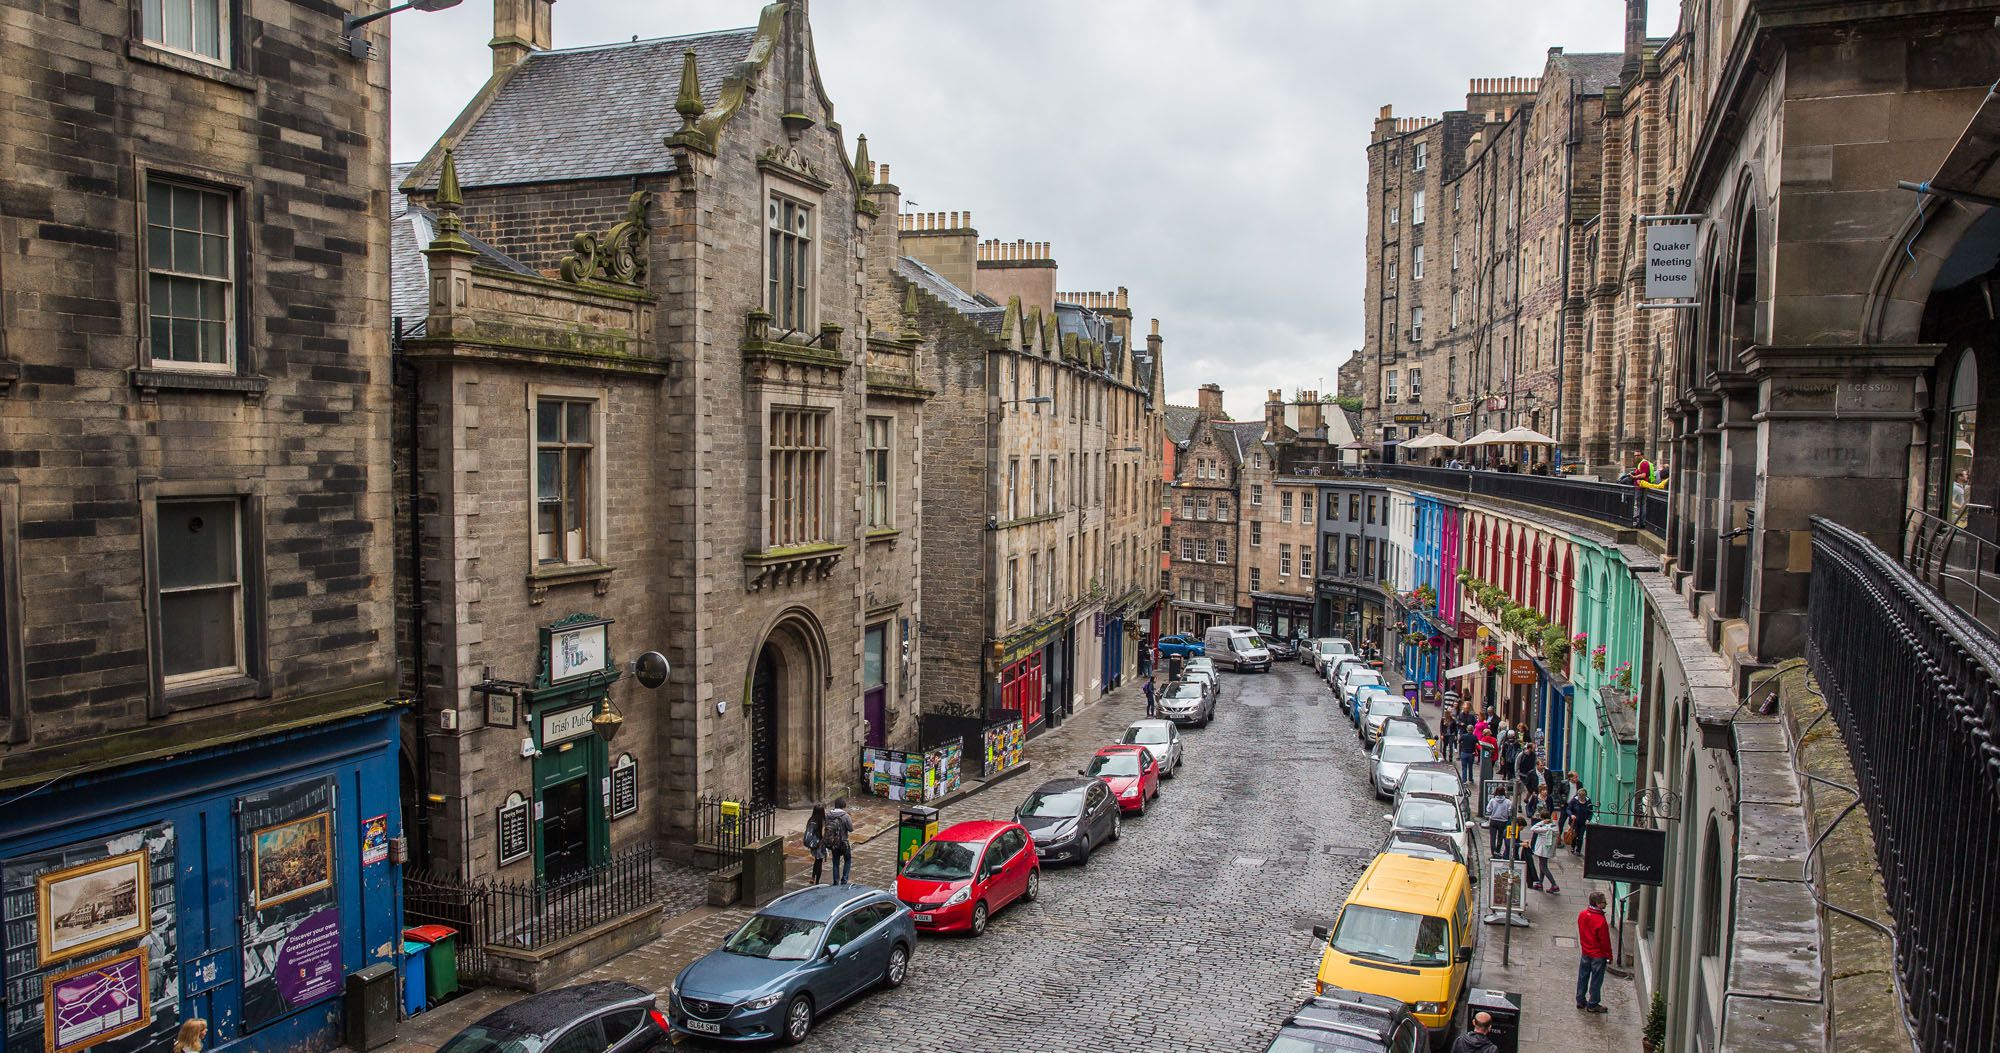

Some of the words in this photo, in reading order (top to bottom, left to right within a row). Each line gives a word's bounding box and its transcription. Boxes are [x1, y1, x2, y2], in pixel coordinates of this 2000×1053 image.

[1653, 242, 1691, 252] Quaker
[1651, 257, 1692, 268] Meeting
[1654, 273, 1688, 282] House
[1846, 383, 1900, 392] ECESSION
[552, 717, 569, 734] Irish
[572, 715, 585, 728] Pub
[1596, 860, 1625, 868] Walker
[1626, 862, 1651, 871] Slater
[290, 931, 312, 943] Discover
[312, 926, 324, 936] your
[325, 923, 336, 931] own
[286, 941, 306, 952] Greater
[690, 1021, 705, 1030] SL64
